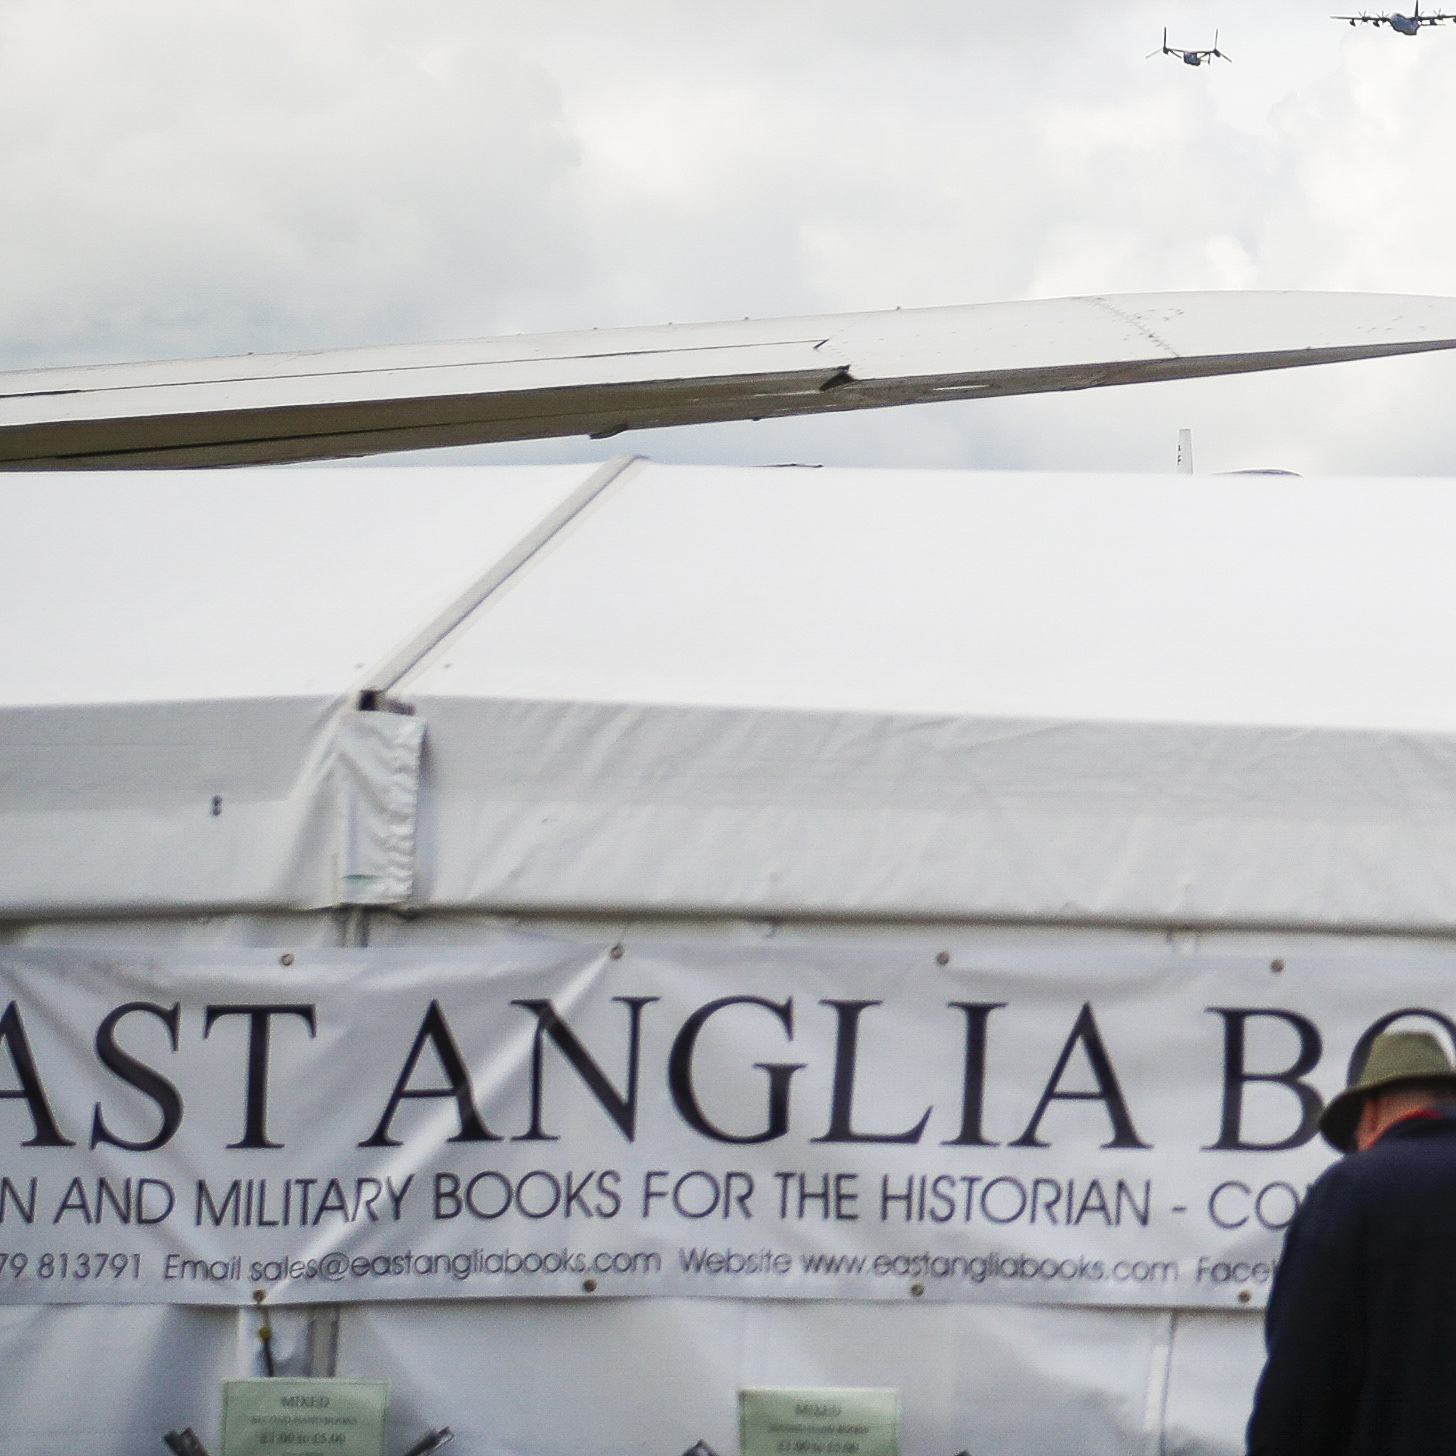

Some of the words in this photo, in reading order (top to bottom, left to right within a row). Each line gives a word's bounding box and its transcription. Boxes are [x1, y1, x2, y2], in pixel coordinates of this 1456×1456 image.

[0, 1000, 317, 1151] AST
[357, 995, 1154, 1150] ANGLIA
[53, 1176, 176, 1225] AND
[195, 1173, 415, 1227] MILITARY
[433, 1169, 622, 1220] BOOKS
[642, 1170, 755, 1220] FOR
[774, 1171, 859, 1221] THE
[881, 1173, 1151, 1227] HISTORIAN
[38, 1252, 141, 1280] 813791
[164, 1254, 241, 1281] Email
[250, 1248, 661, 1282] sales@eastangliabooks.com
[679, 1247, 793, 1275] Website
[803, 1250, 1179, 1284] www.eastangliabooks.com
[281, 1396, 330, 1408] MIXED
